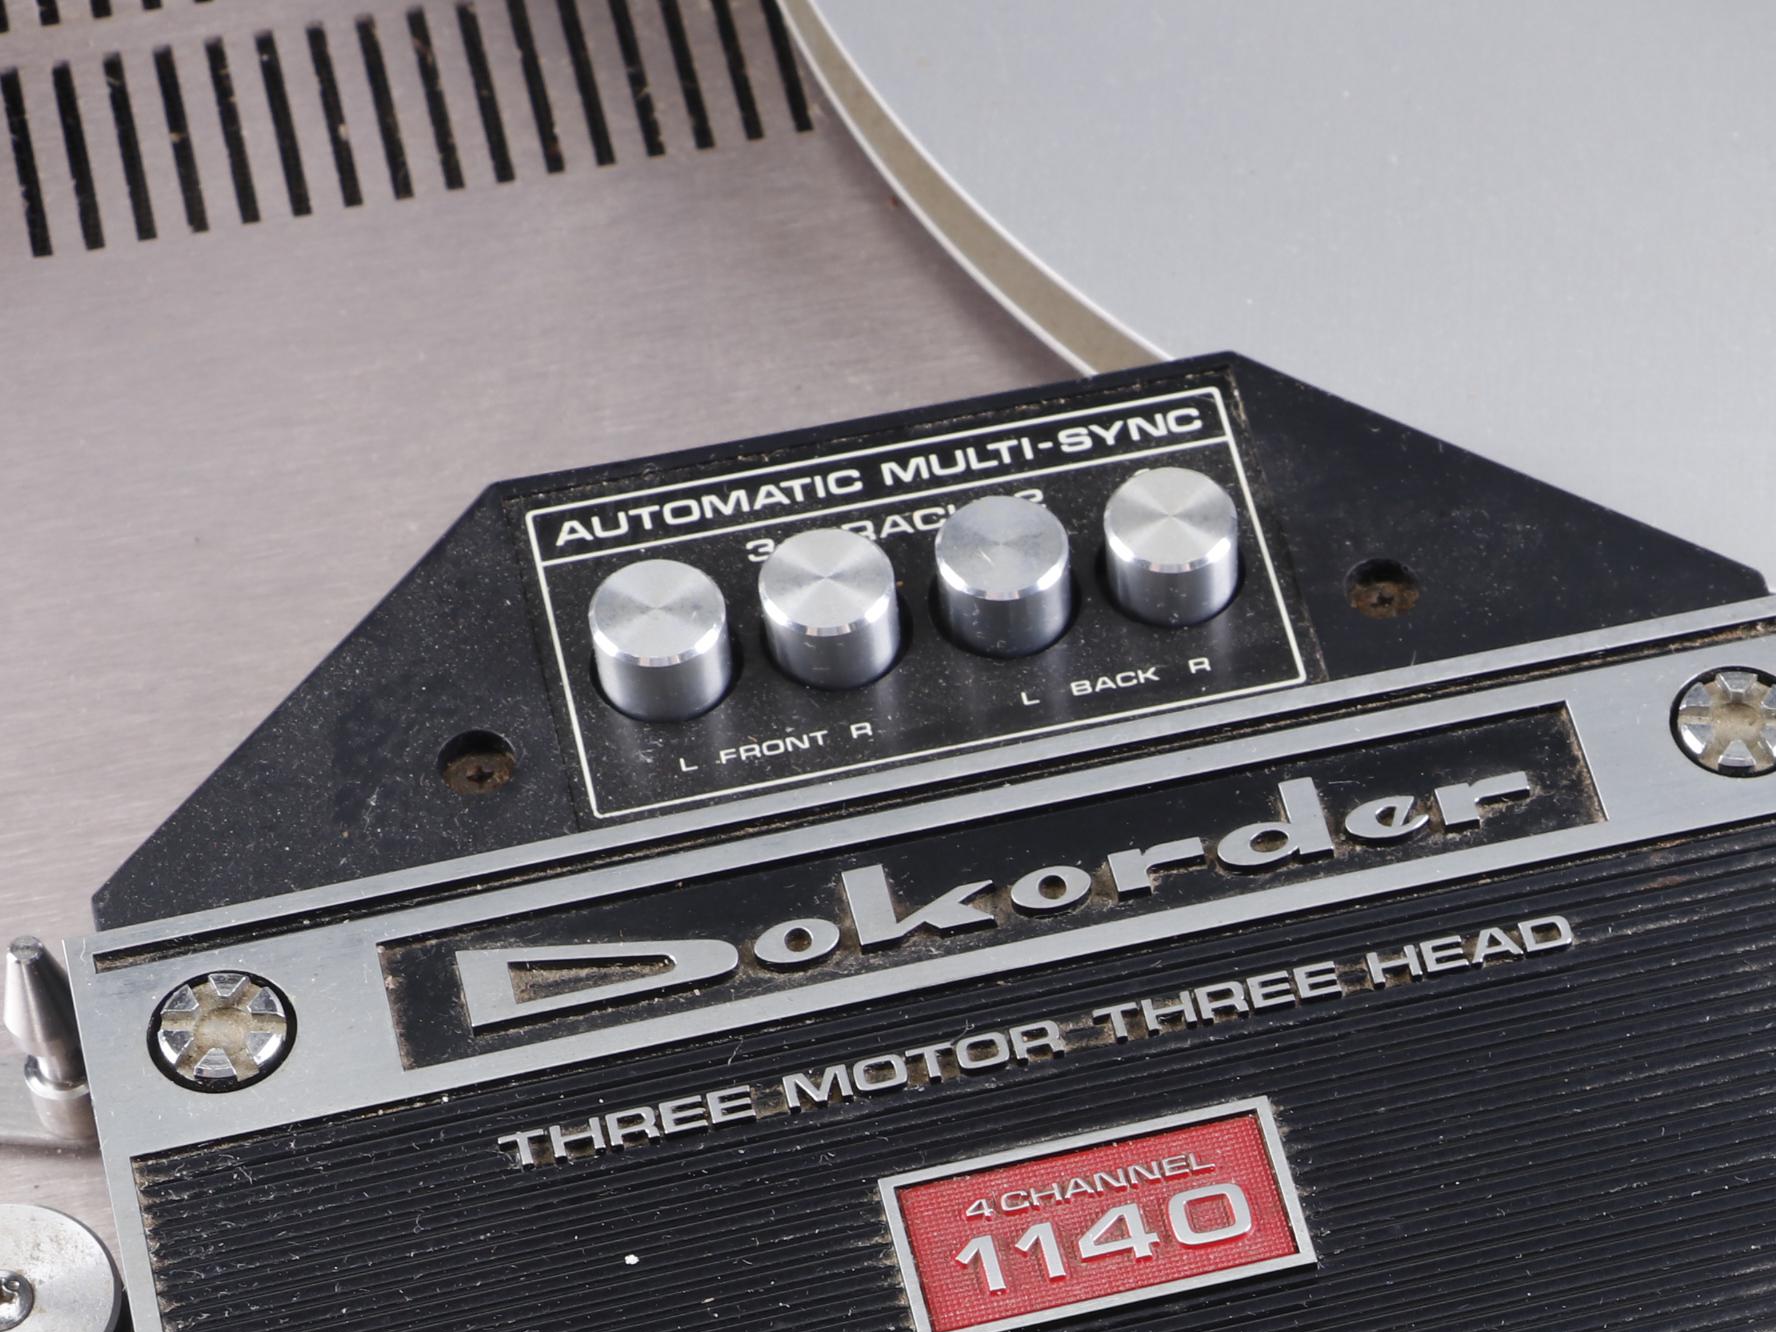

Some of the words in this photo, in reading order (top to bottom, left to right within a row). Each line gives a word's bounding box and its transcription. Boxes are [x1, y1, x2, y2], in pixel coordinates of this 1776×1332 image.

[555, 468, 864, 547] AUTOMATIC
[881, 406, 1203, 486] MULTI-SYNC
[746, 538, 775, 562] 3
[1020, 691, 1041, 706] L
[1069, 666, 1160, 696] BACK
[1187, 656, 1212, 674] R
[679, 757, 699, 772] L
[718, 729, 828, 765] FRONT
[849, 721, 873, 739] R
[455, 771, 1531, 1032] Dokorder
[499, 1085, 757, 1169] THREE
[782, 1019, 1065, 1112] MOTOR
[1093, 961, 1343, 1043] THREE
[1366, 915, 1574, 989] HEAD
[1000, 1152, 1216, 1212] CHANNEL
[956, 1183, 1252, 1293] 1140
